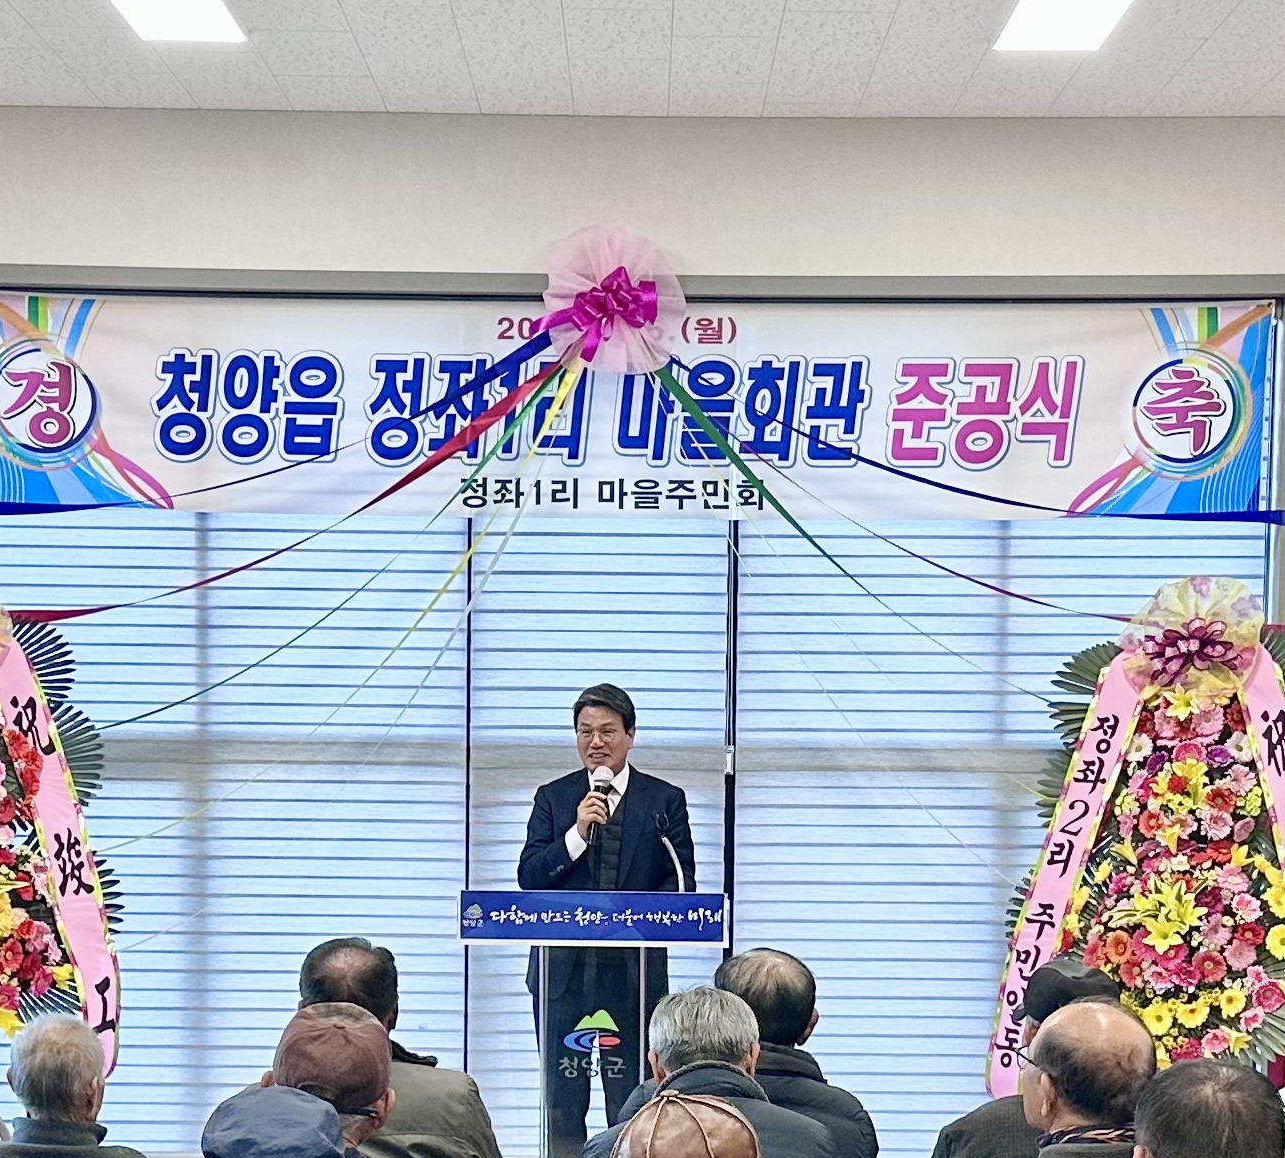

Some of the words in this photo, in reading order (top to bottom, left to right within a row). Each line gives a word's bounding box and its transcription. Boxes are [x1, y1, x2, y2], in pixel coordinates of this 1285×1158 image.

[681, 316, 737, 343] (월)
[2, 358, 78, 447] 경
[154, 350, 340, 462] 청양읍
[614, 353, 868, 468] 마을회관
[886, 355, 1084, 468] 준공식
[1140, 370, 1225, 454] 축
[460, 476, 579, 510] 정좌1리
[597, 477, 765, 511] 마을주민회
[1045, 713, 1121, 879] 정좌2리
[489, 904, 538, 925] 다함께
[540, 909, 571, 924] 만드는
[612, 908, 643, 926] 더불어
[645, 910, 684, 926] 행복한
[687, 907, 722, 931] 미래
[558, 1056, 626, 1079] 청양군
